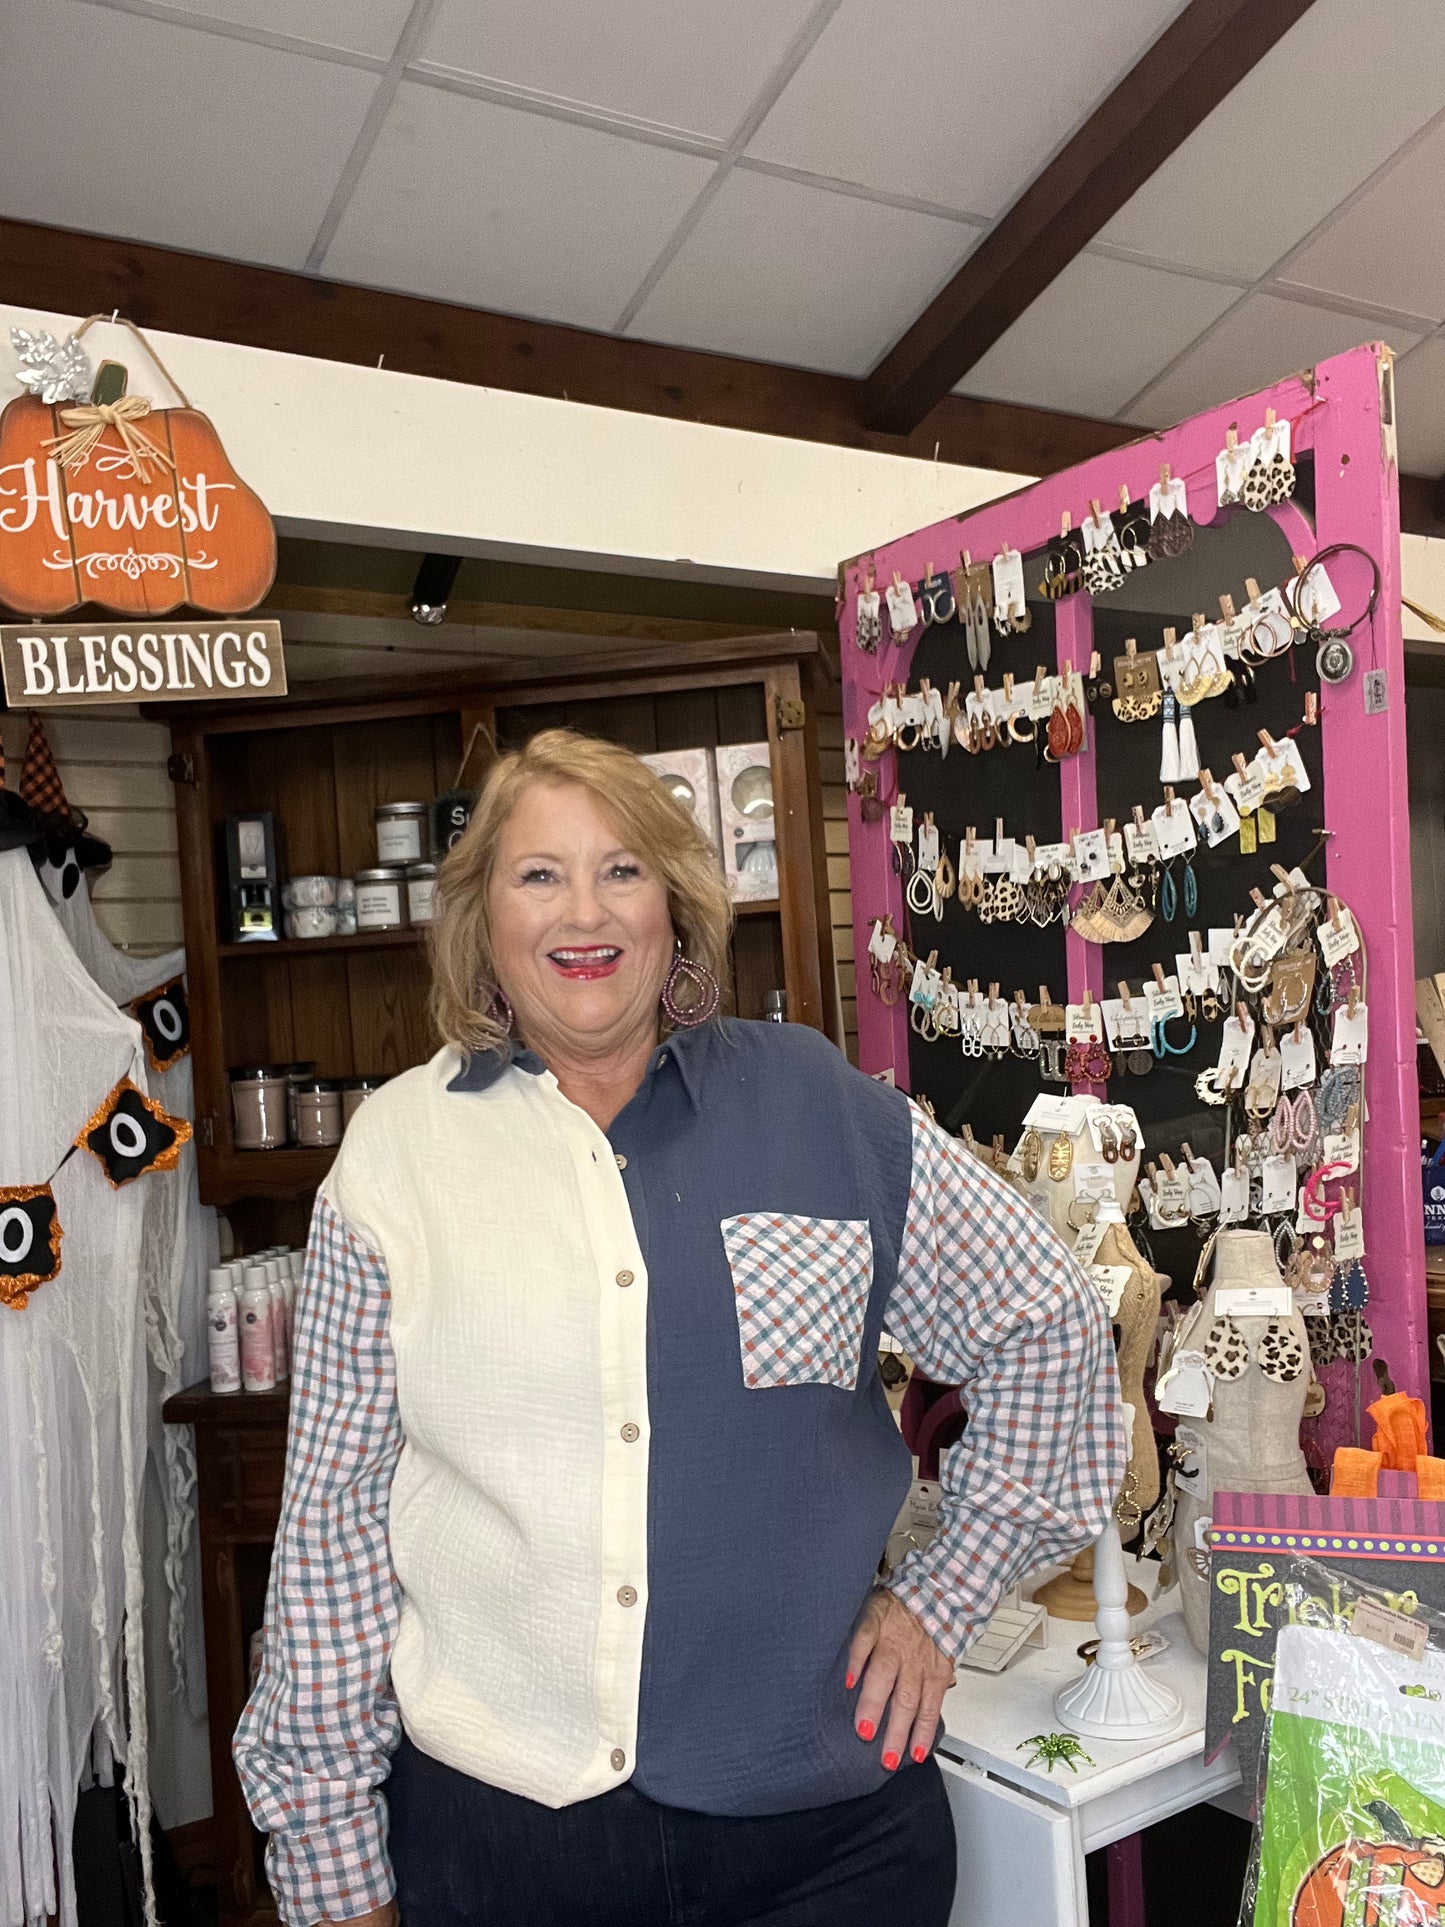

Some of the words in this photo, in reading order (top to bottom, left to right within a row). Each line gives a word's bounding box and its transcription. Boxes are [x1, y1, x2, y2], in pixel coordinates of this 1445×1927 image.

[0, 457, 236, 541] Harvest
[17, 631, 271, 695] BLESSINGS
[152, 999, 183, 1042] O
[110, 1112, 147, 1158] O
[0, 1207, 33, 1263] O
